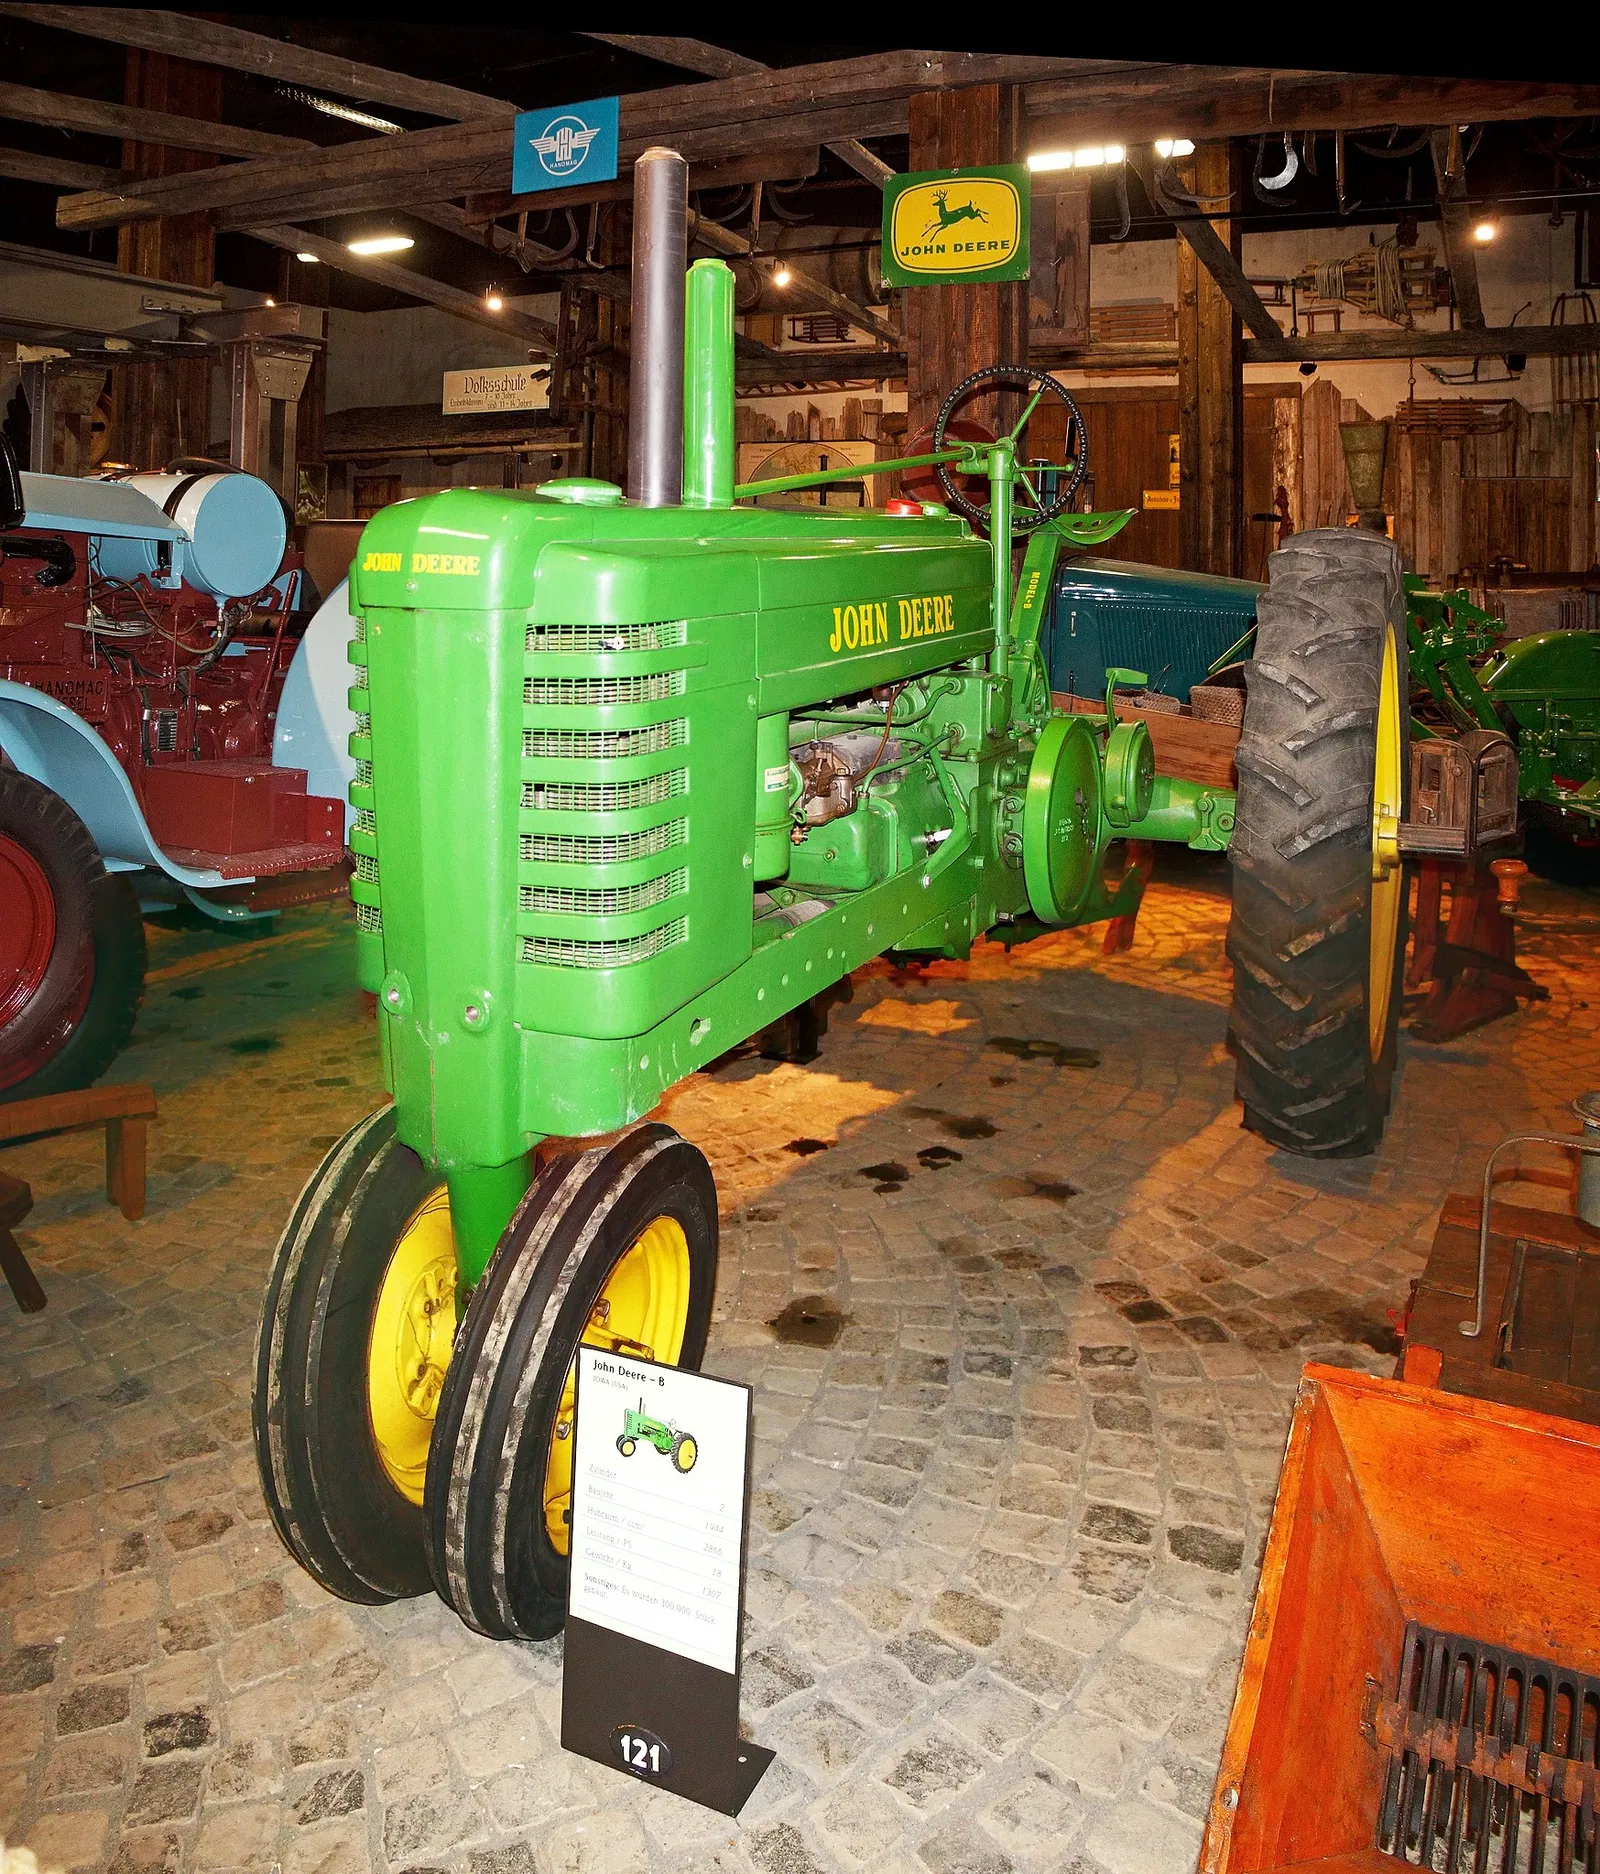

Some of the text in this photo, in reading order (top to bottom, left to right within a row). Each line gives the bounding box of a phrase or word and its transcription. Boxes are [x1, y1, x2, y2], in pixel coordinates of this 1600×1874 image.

[549, 160, 578, 169] HANOMAG
[901, 240, 1010, 256] JOHN DEERE
[464, 373, 527, 394] Volksschule
[363, 552, 481, 576] JOHN DEERE
[1023, 571, 1041, 609] MODEL-B
[829, 595, 954, 653] JOHN DEERE
[35, 680, 104, 696] HANOMAG
[593, 1359, 615, 1374] John
[618, 1365, 647, 1382] Deere
[658, 1376, 665, 1387] B
[589, 1463, 725, 1513] Zylinder 2
[587, 1505, 619, 1523] Hubraum
[588, 1484, 724, 1533] Baujahr 1944
[586, 1526, 615, 1545] Leistung
[712, 1567, 723, 1578] 18
[585, 1547, 614, 1565] Gewicht
[701, 1586, 722, 1600] 1307
[584, 1572, 621, 1592] Sonstiges:
[621, 1584, 630, 1595] Es
[631, 1589, 659, 1605] wurden
[695, 1610, 716, 1625] Stück
[620, 1734, 660, 1772] 121
